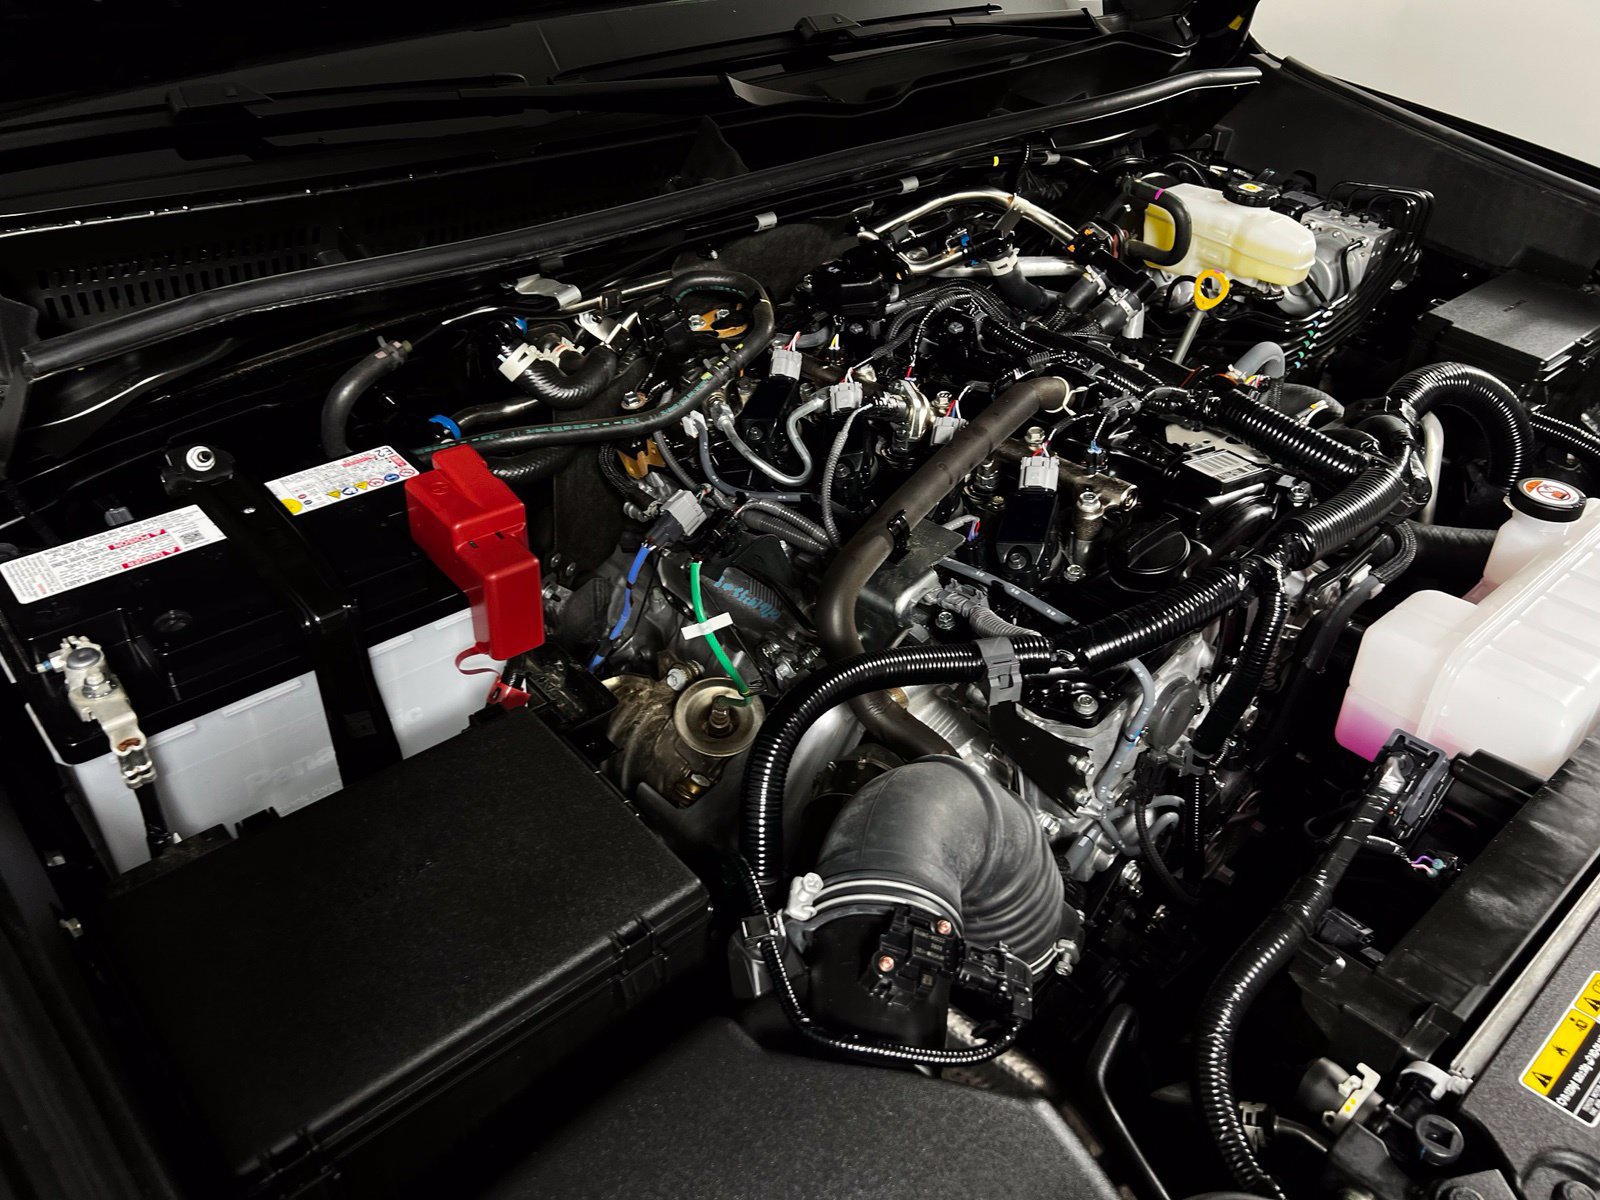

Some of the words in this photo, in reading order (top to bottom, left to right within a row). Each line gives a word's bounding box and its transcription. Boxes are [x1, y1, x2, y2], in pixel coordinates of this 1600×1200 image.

[112, 533, 150, 549] POISON
[42, 543, 75, 556] CHILDREN
[87, 546, 108, 557] CAUSES
[49, 558, 69, 569] BURNS
[67, 552, 88, 563] SEVERE
[125, 551, 164, 567] DANGER
[85, 564, 122, 580] EXPLOSIVE
[62, 576, 86, 588] GASES
